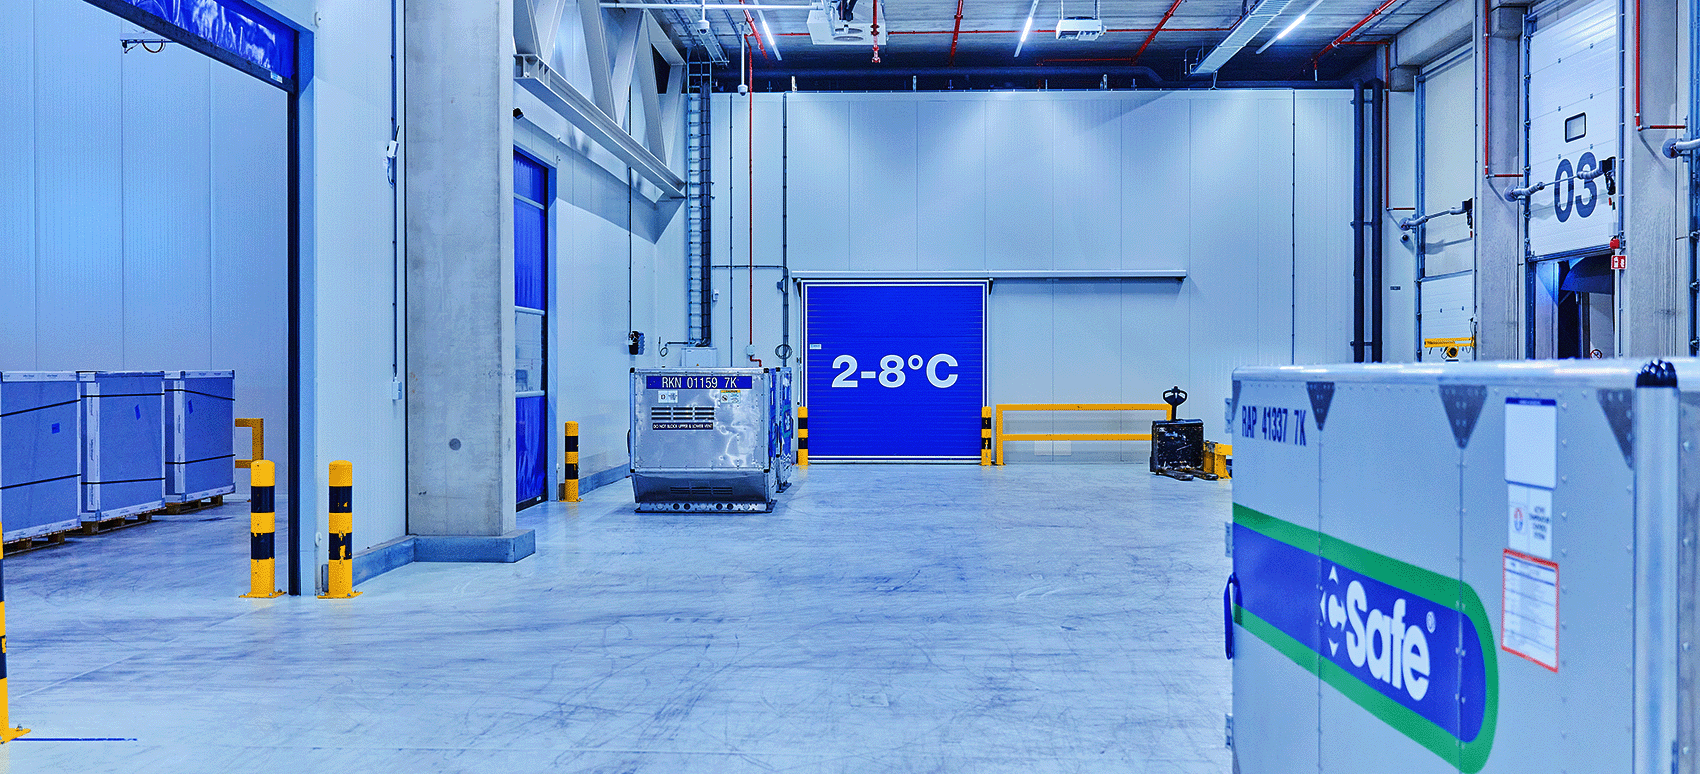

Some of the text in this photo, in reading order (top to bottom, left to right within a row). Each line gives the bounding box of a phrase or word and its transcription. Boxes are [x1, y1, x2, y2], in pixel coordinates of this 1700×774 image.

[1554, 151, 1598, 223] 03
[662, 377, 737, 388] RKN 01159 7K
[1241, 405, 1307, 446] RAP 41337 7K
